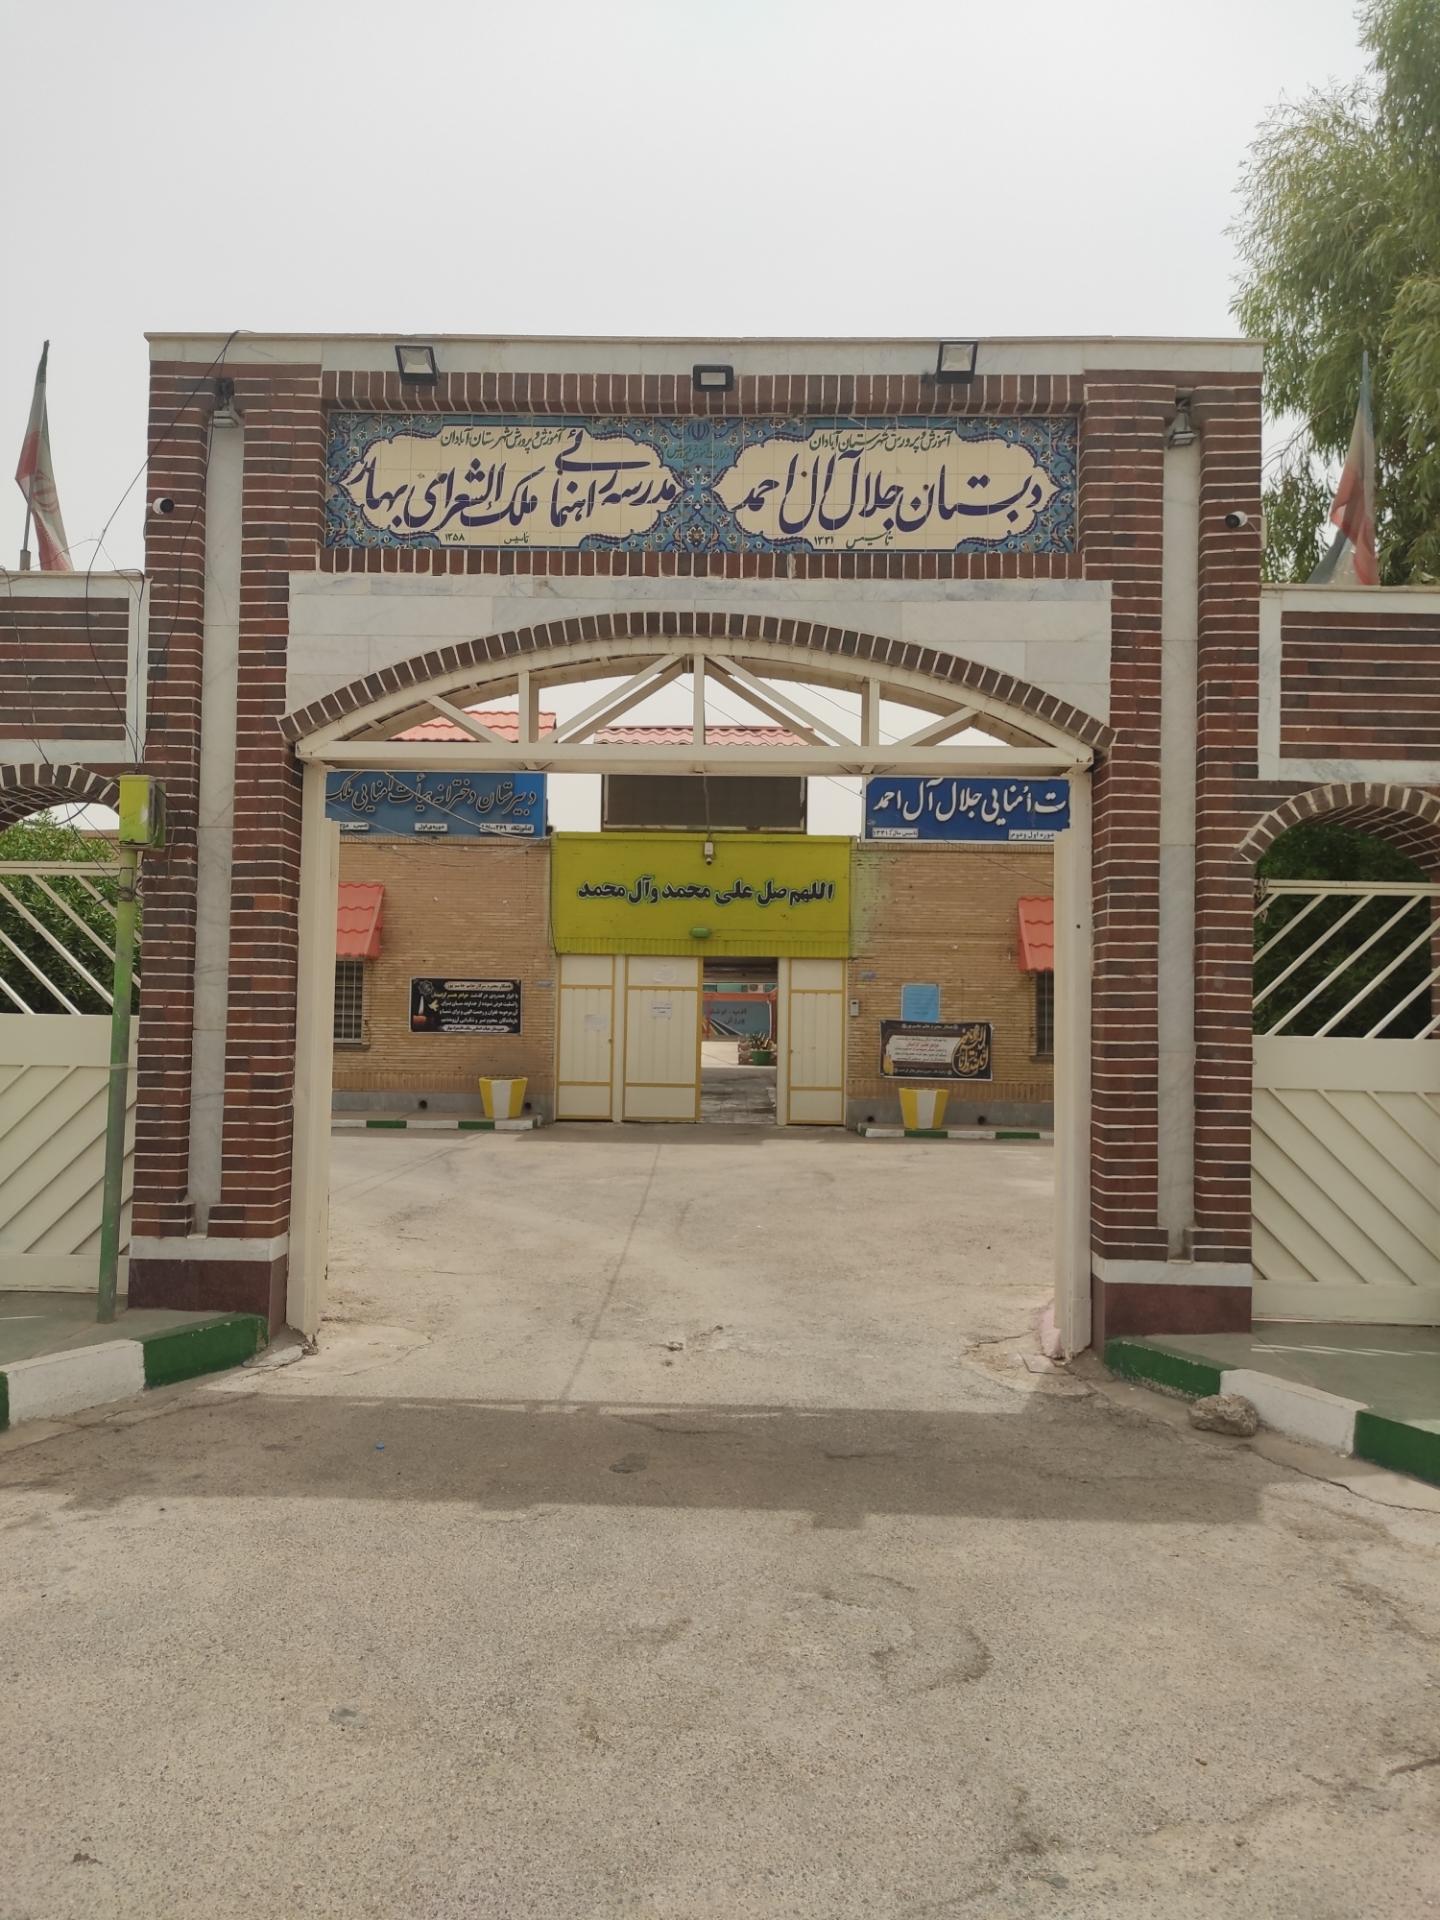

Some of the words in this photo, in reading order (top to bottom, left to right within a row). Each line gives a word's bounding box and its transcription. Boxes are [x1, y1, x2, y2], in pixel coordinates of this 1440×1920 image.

[440, 427, 474, 447] آبادان
[469, 426, 514, 450] شهرستان
[505, 427, 533, 455] پرورش
[532, 427, 567, 450] آموزش
[808, 430, 845, 451] آبادان
[839, 431, 890, 452] شهرستان
[884, 432, 920, 453] پرورش
[920, 429, 953, 452] آموزش
[346, 456, 409, 529] بهار
[403, 457, 507, 533] الشعرای
[600, 478, 677, 506] مدرسه
[731, 452, 799, 512] احمد
[818, 455, 904, 532] جلال
[460, 465, 546, 527] ملک
[895, 463, 1043, 533] دبستان
[432, 777, 477, 811] دخترانه
[475, 780, 538, 816] دبیرستان
[872, 789, 902, 811] احمد
[902, 776, 945, 822] آل
[935, 781, 983, 822] جلال
[577, 881, 626, 900] محمد
[661, 881, 711, 900] محمد
[757, 882, 788, 906] صل
[790, 881, 833, 905] اللهم
